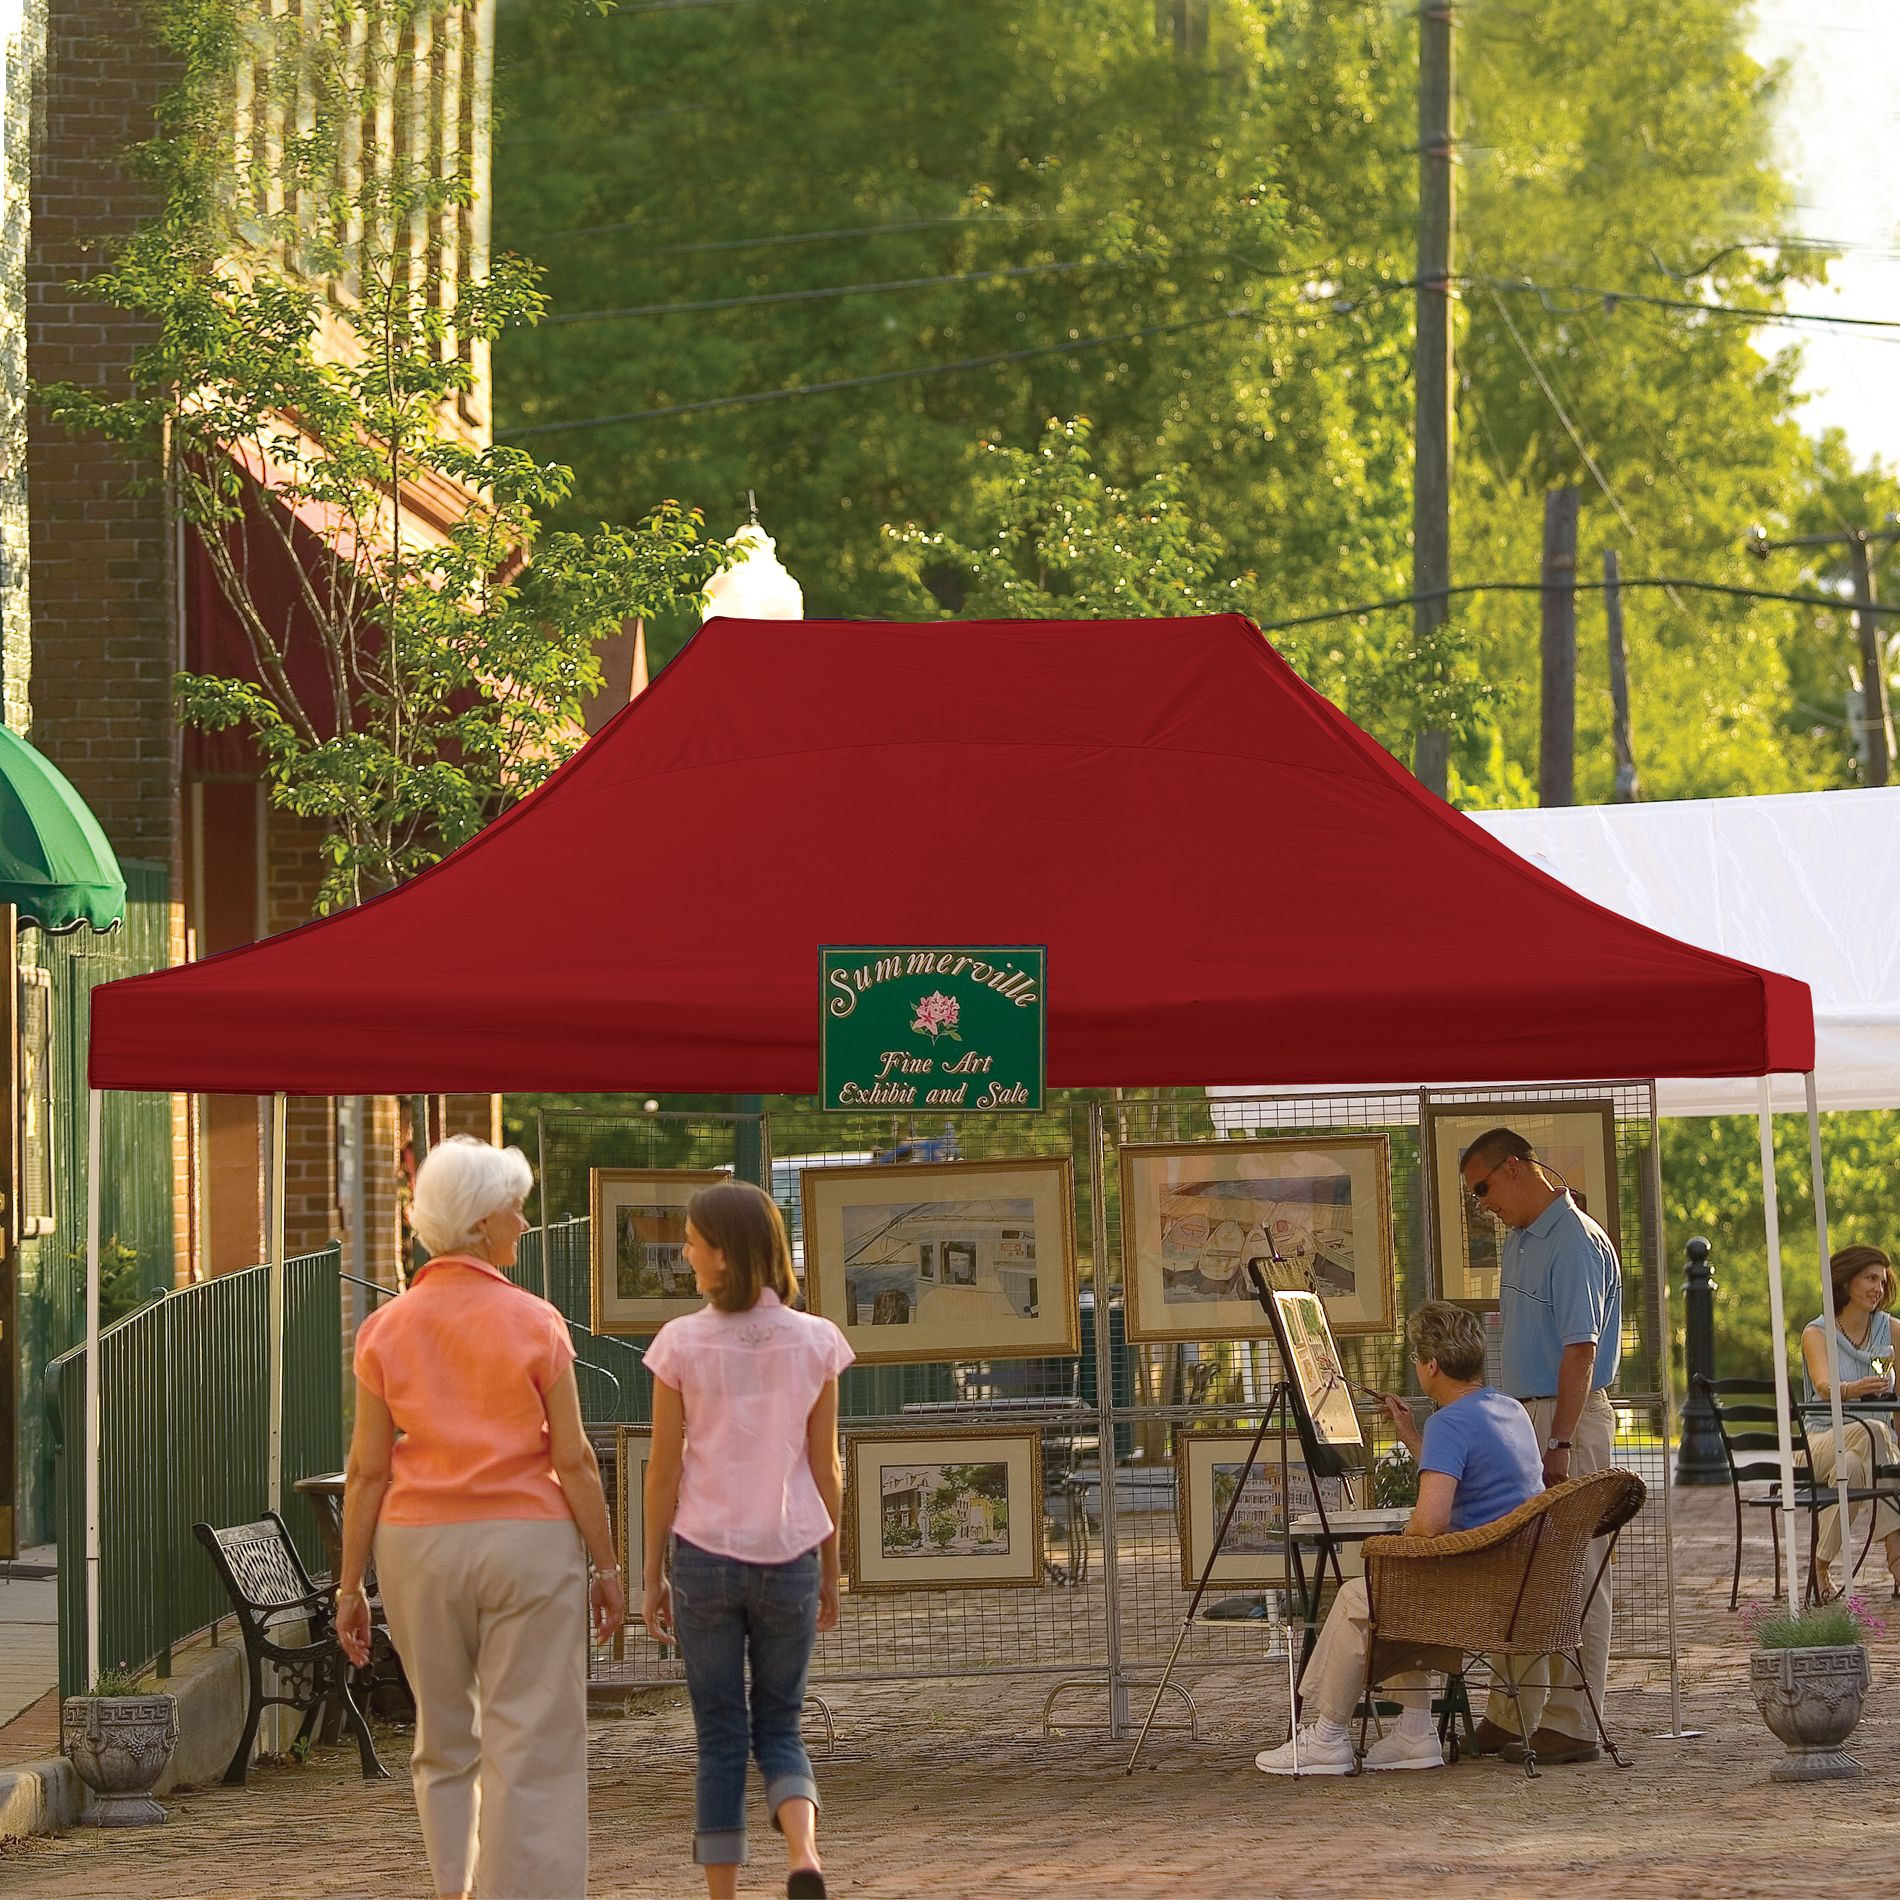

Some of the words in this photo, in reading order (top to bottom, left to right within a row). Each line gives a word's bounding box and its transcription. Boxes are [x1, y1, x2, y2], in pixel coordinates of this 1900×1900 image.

[830, 952, 1037, 1017] Summerville
[874, 1051, 933, 1079] Fine
[941, 1051, 993, 1073] Art
[838, 1081, 917, 1104] Exhibit
[925, 1082, 968, 1104] and
[976, 1081, 1029, 1109] Sale
